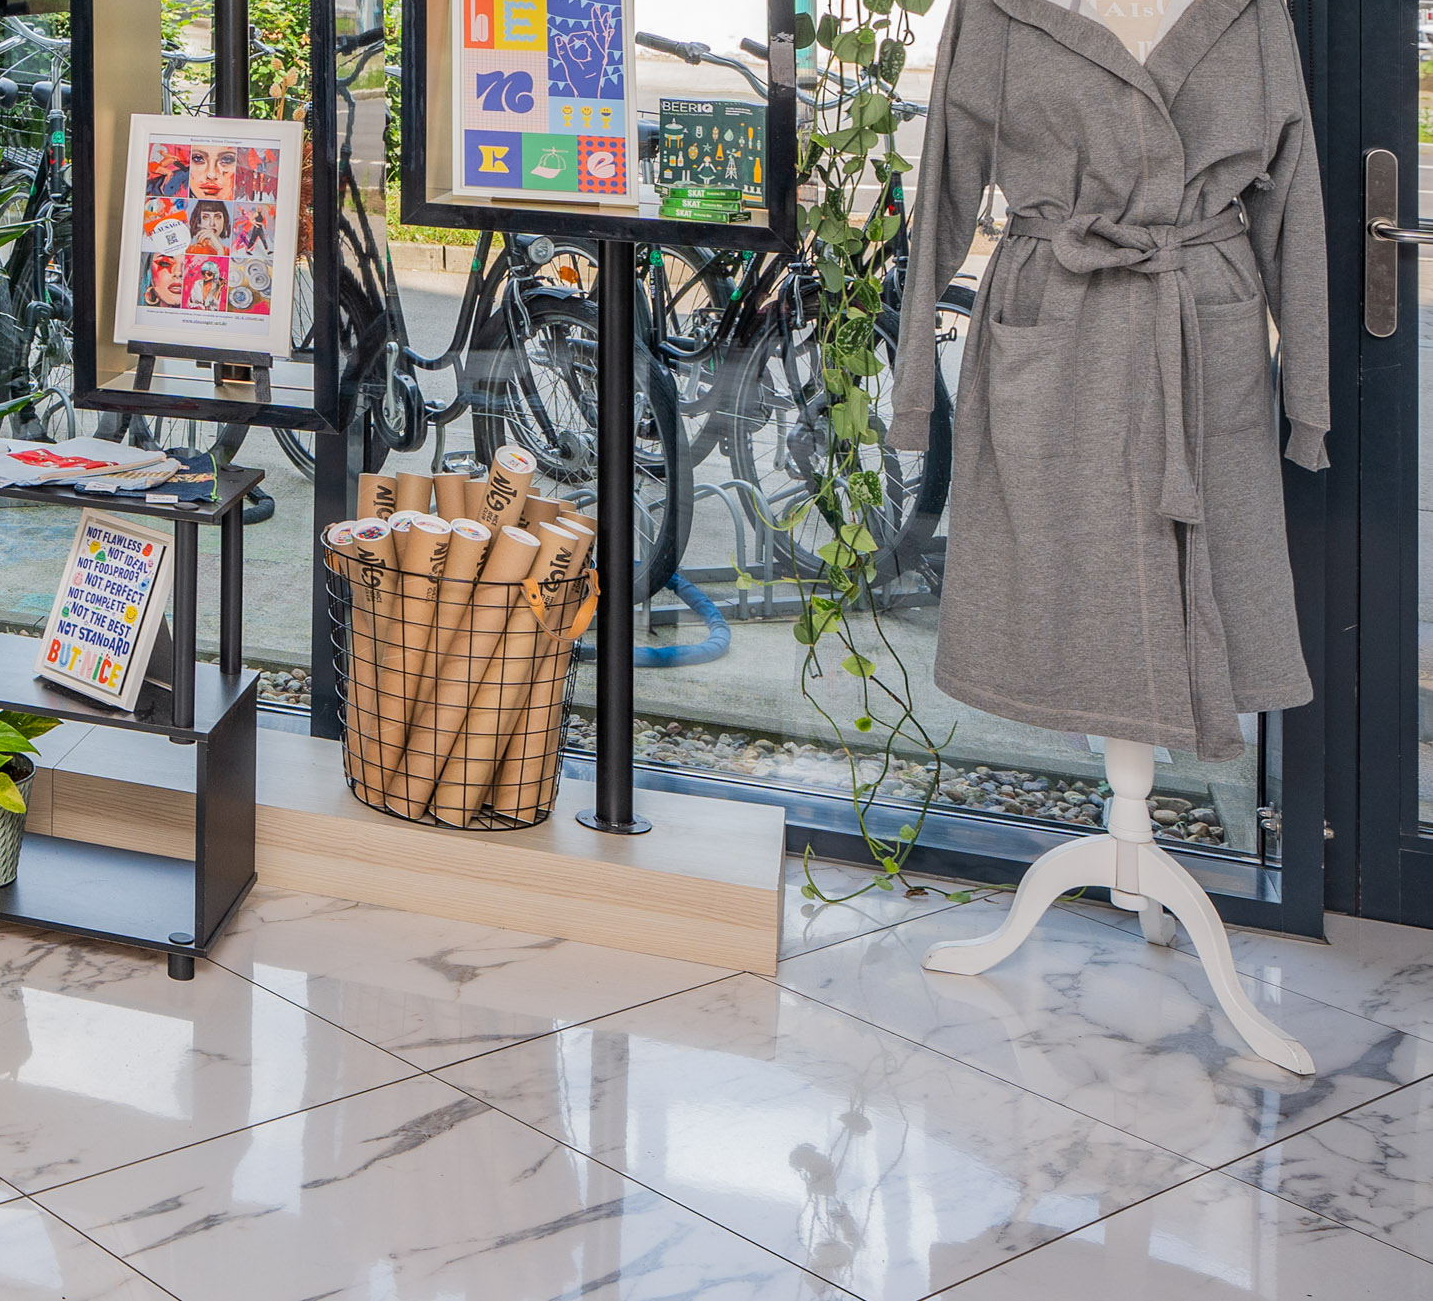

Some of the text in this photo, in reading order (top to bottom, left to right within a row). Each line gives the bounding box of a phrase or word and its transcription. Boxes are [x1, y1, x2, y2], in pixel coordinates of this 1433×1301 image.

[661, 101, 714, 114] BEERIQ
[682, 199, 702, 208] SKAT
[687, 189, 706, 198] SKAT
[675, 208, 693, 217] SKAT
[86, 526, 142, 553] NOT FLAWLESS
[77, 557, 93, 571] NOT
[107, 546, 148, 574] NOT IDEAL
[67, 586, 84, 600] NOT
[84, 572, 145, 606] NOT PERFECT
[70, 601, 132, 638] NOT THE BEST
[57, 620, 130, 657] NOT STANDARD
[47, 638, 82, 671] BUT
